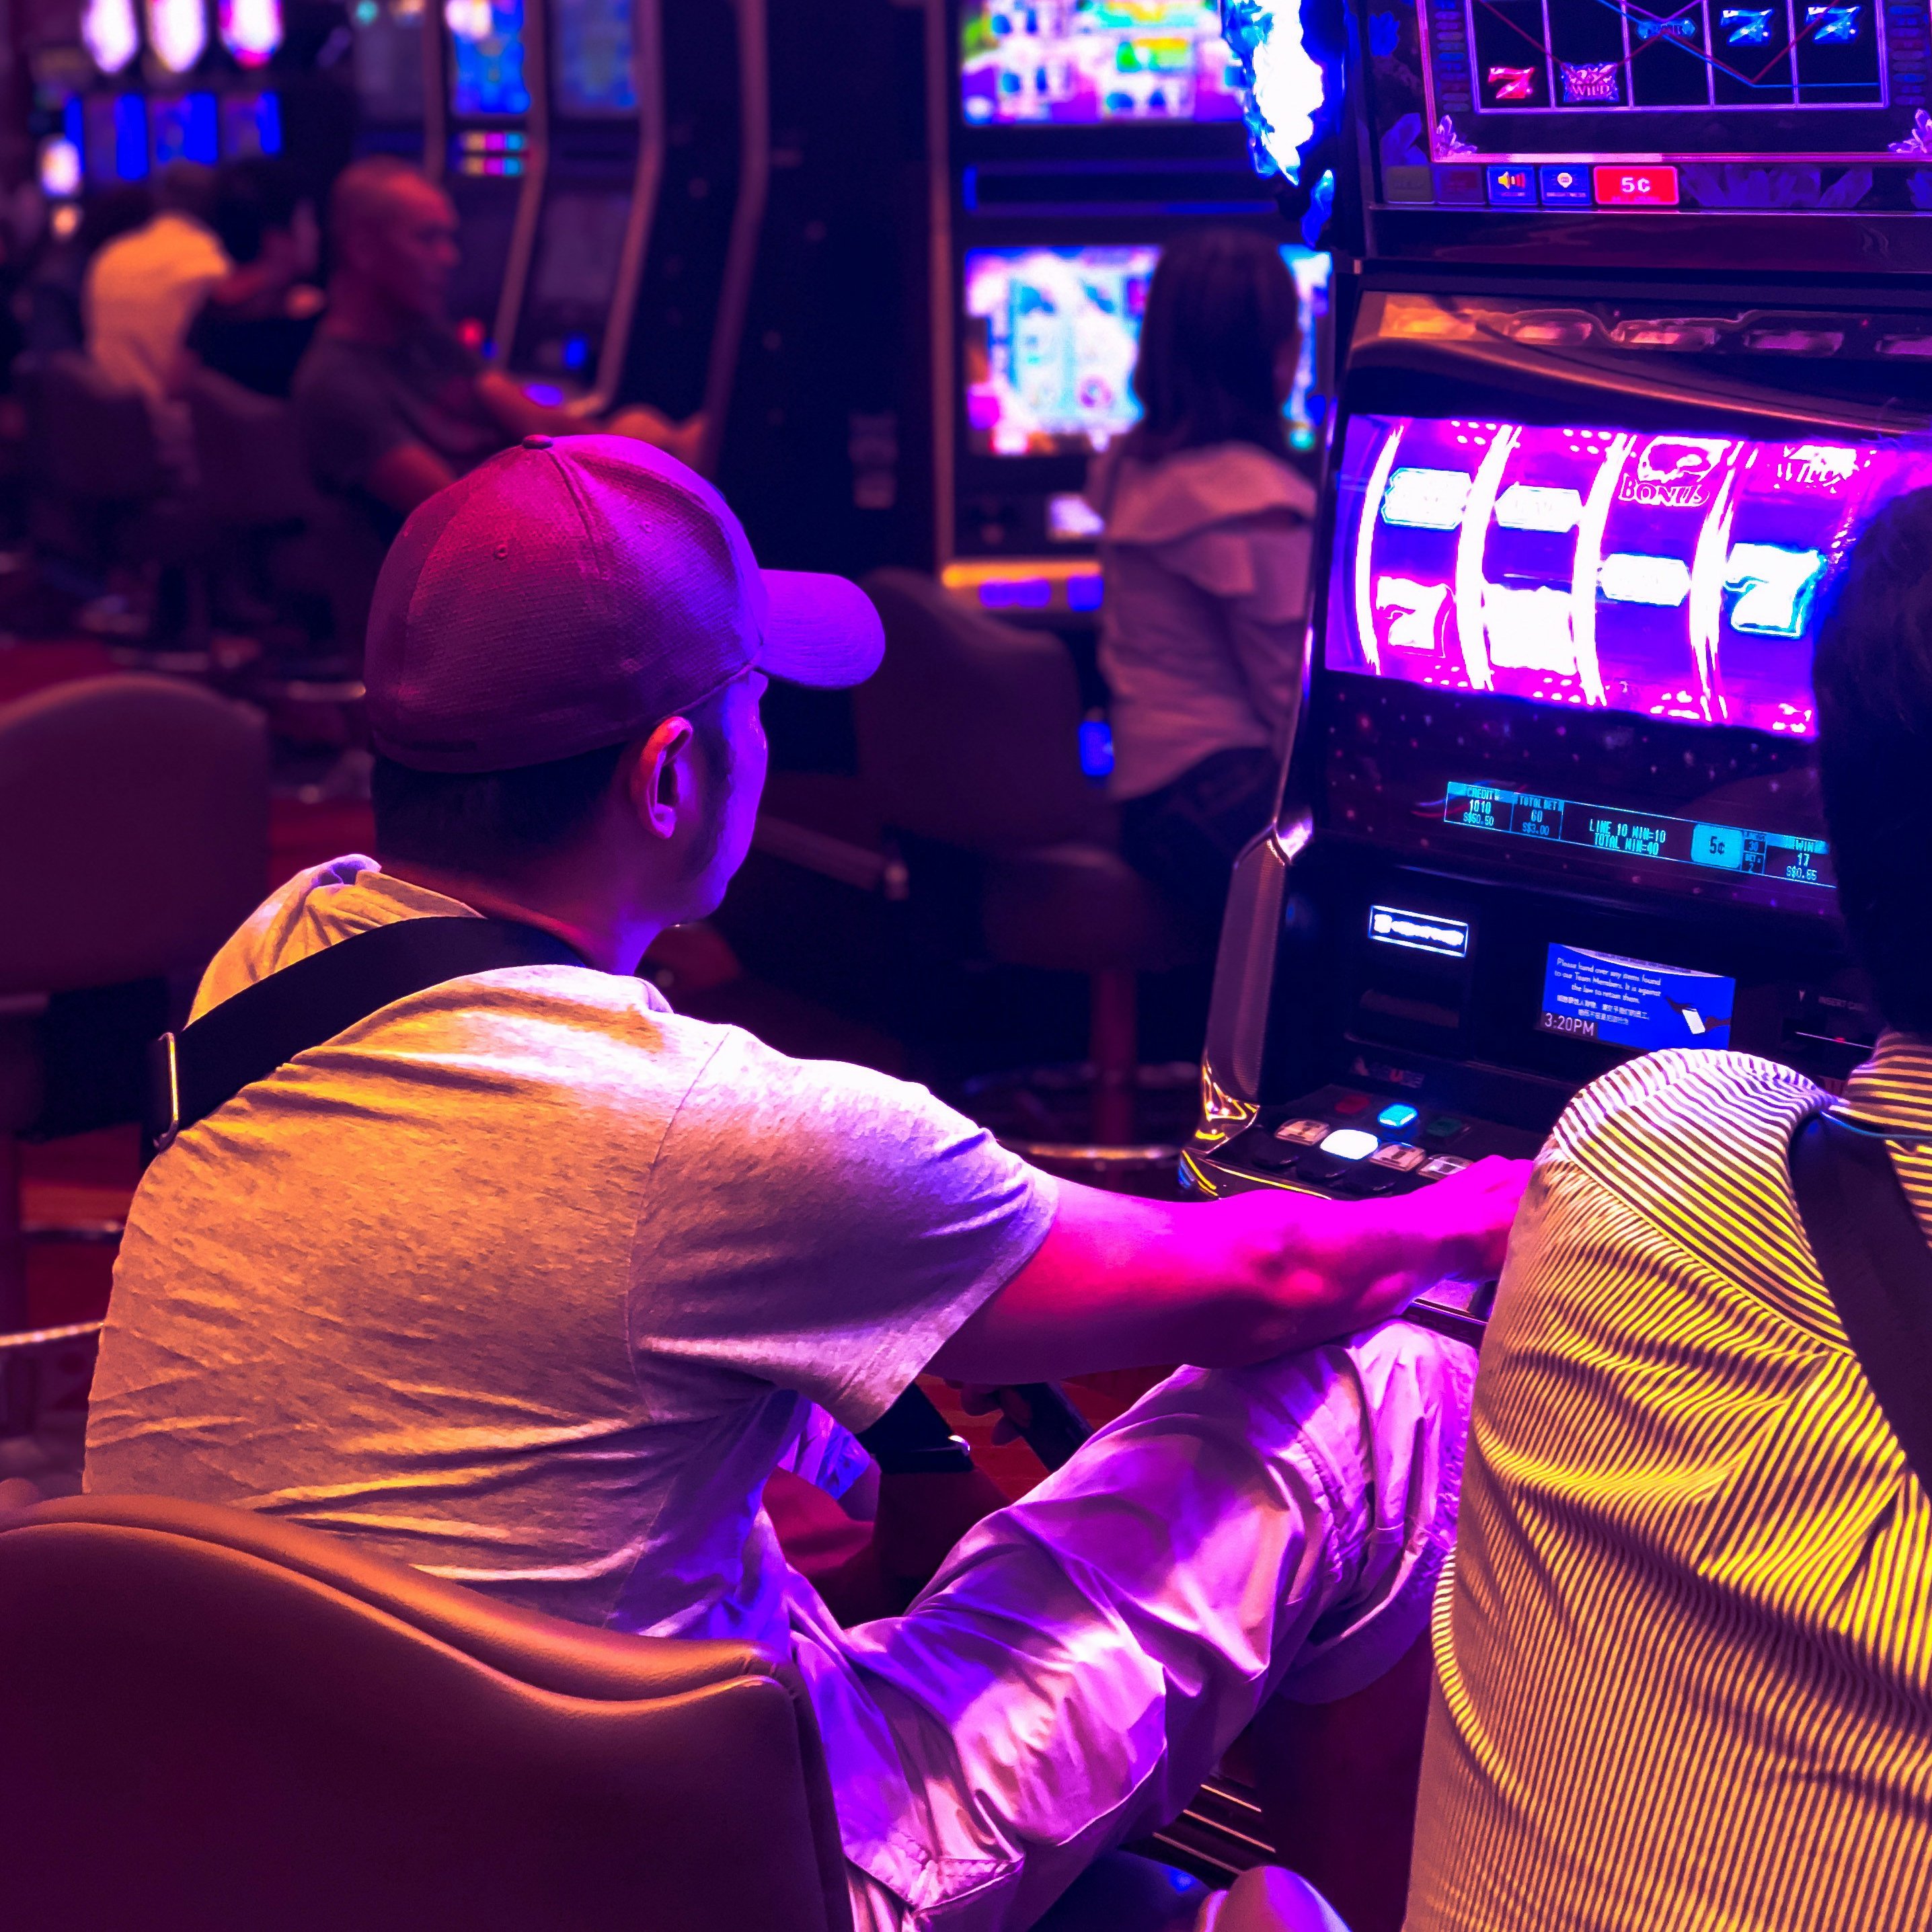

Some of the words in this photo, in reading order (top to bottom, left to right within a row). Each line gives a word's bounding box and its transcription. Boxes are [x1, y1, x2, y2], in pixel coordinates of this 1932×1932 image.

[1469, 799, 1492, 814] 1010
[1531, 809, 1543, 822] 60
[1589, 818, 1612, 835] LINE
[1617, 823, 1627, 837] 10
[1797, 853, 1810, 867] 17
[1545, 1012, 1595, 1036] 3:20PM
